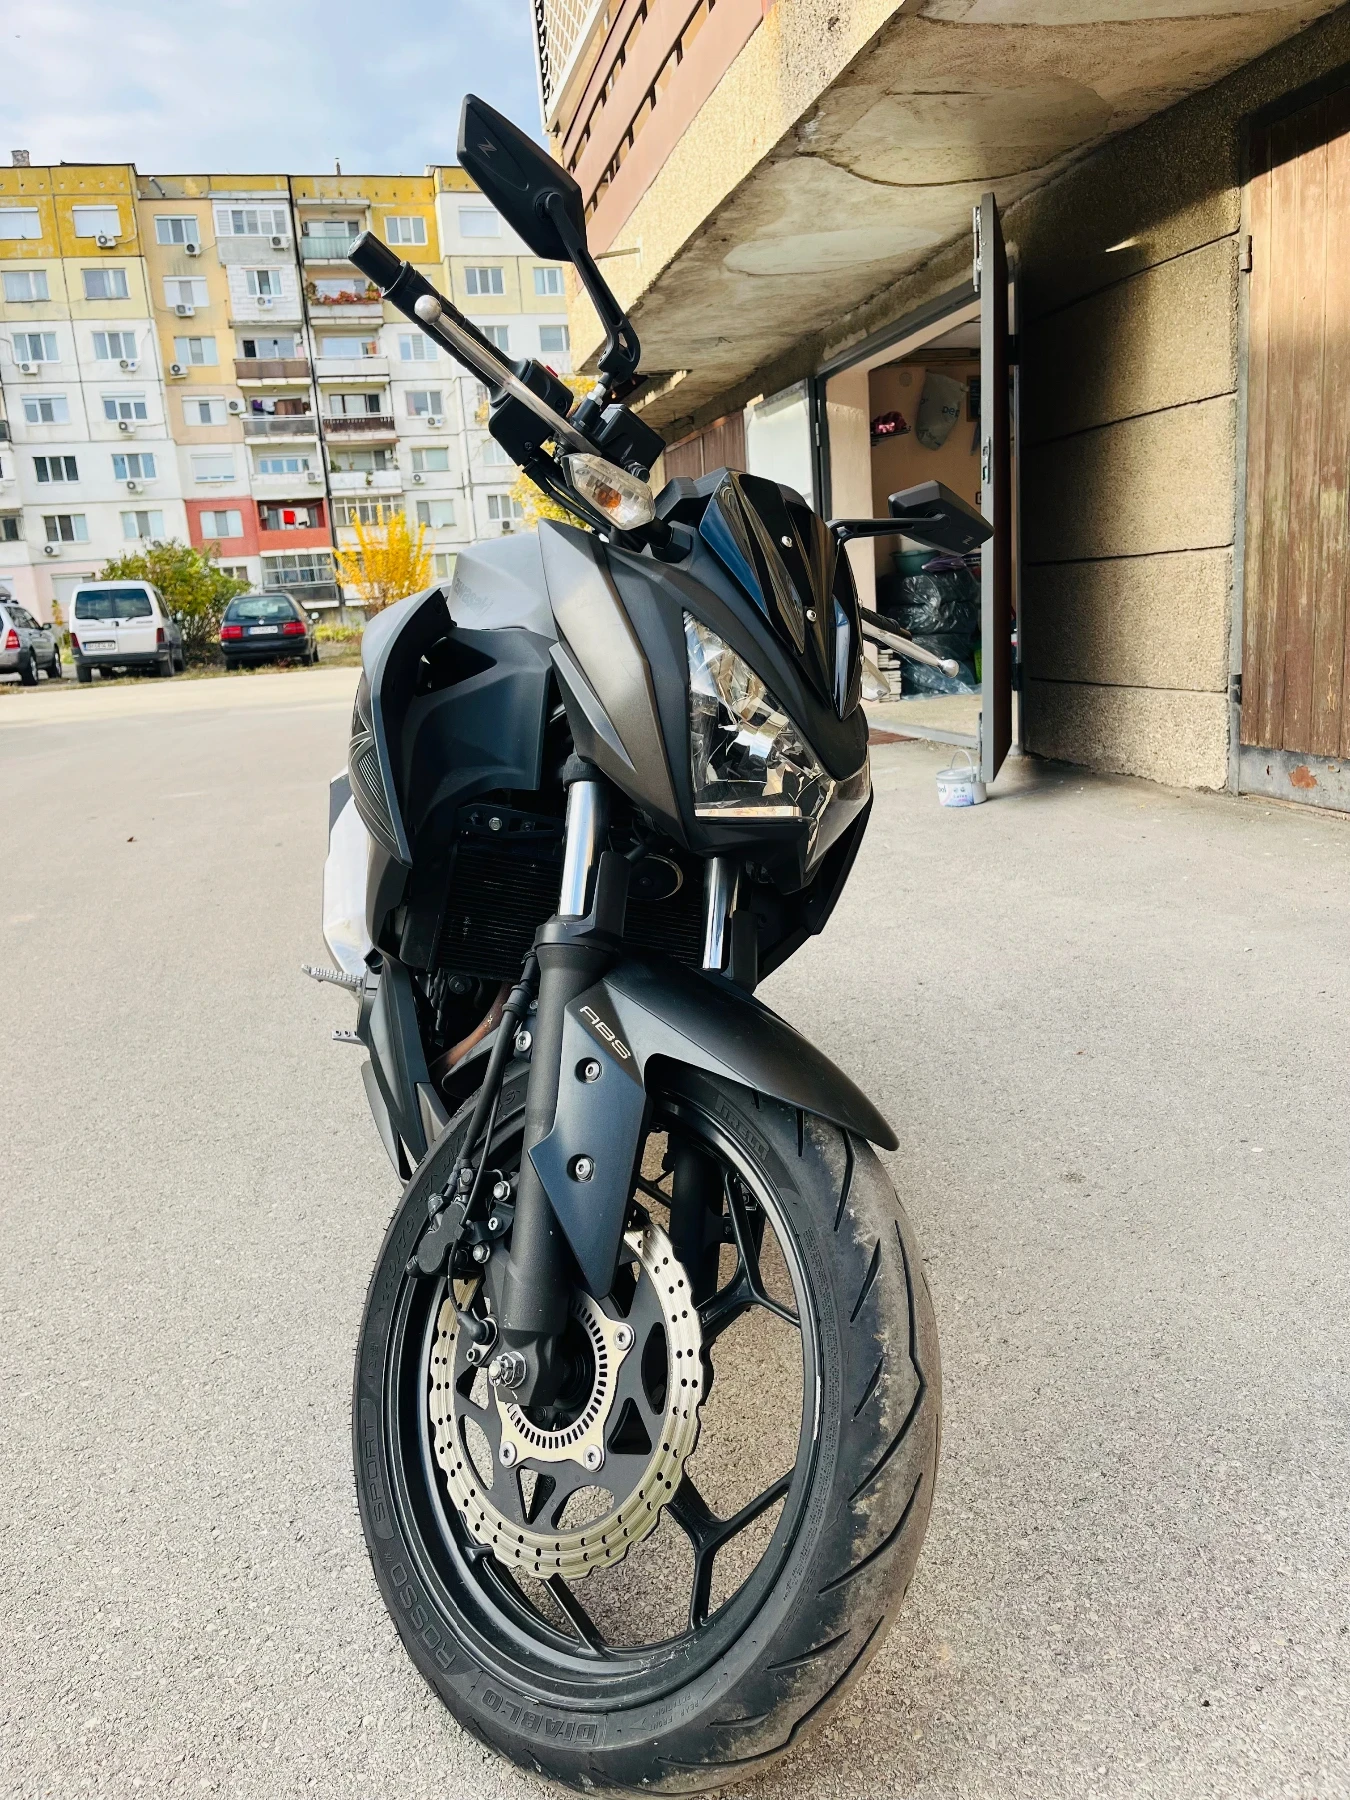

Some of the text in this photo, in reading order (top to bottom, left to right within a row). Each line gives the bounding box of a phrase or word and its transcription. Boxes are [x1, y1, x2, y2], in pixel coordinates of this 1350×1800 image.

[579, 1005, 631, 1060] ABS
[714, 1094, 770, 1161] PIRELLI
[364, 1419, 386, 1524] SPORT
[390, 1562, 456, 1669] ROSSO
[481, 1688, 600, 1747] DIABLO
[649, 1716, 673, 1731] FRONT
